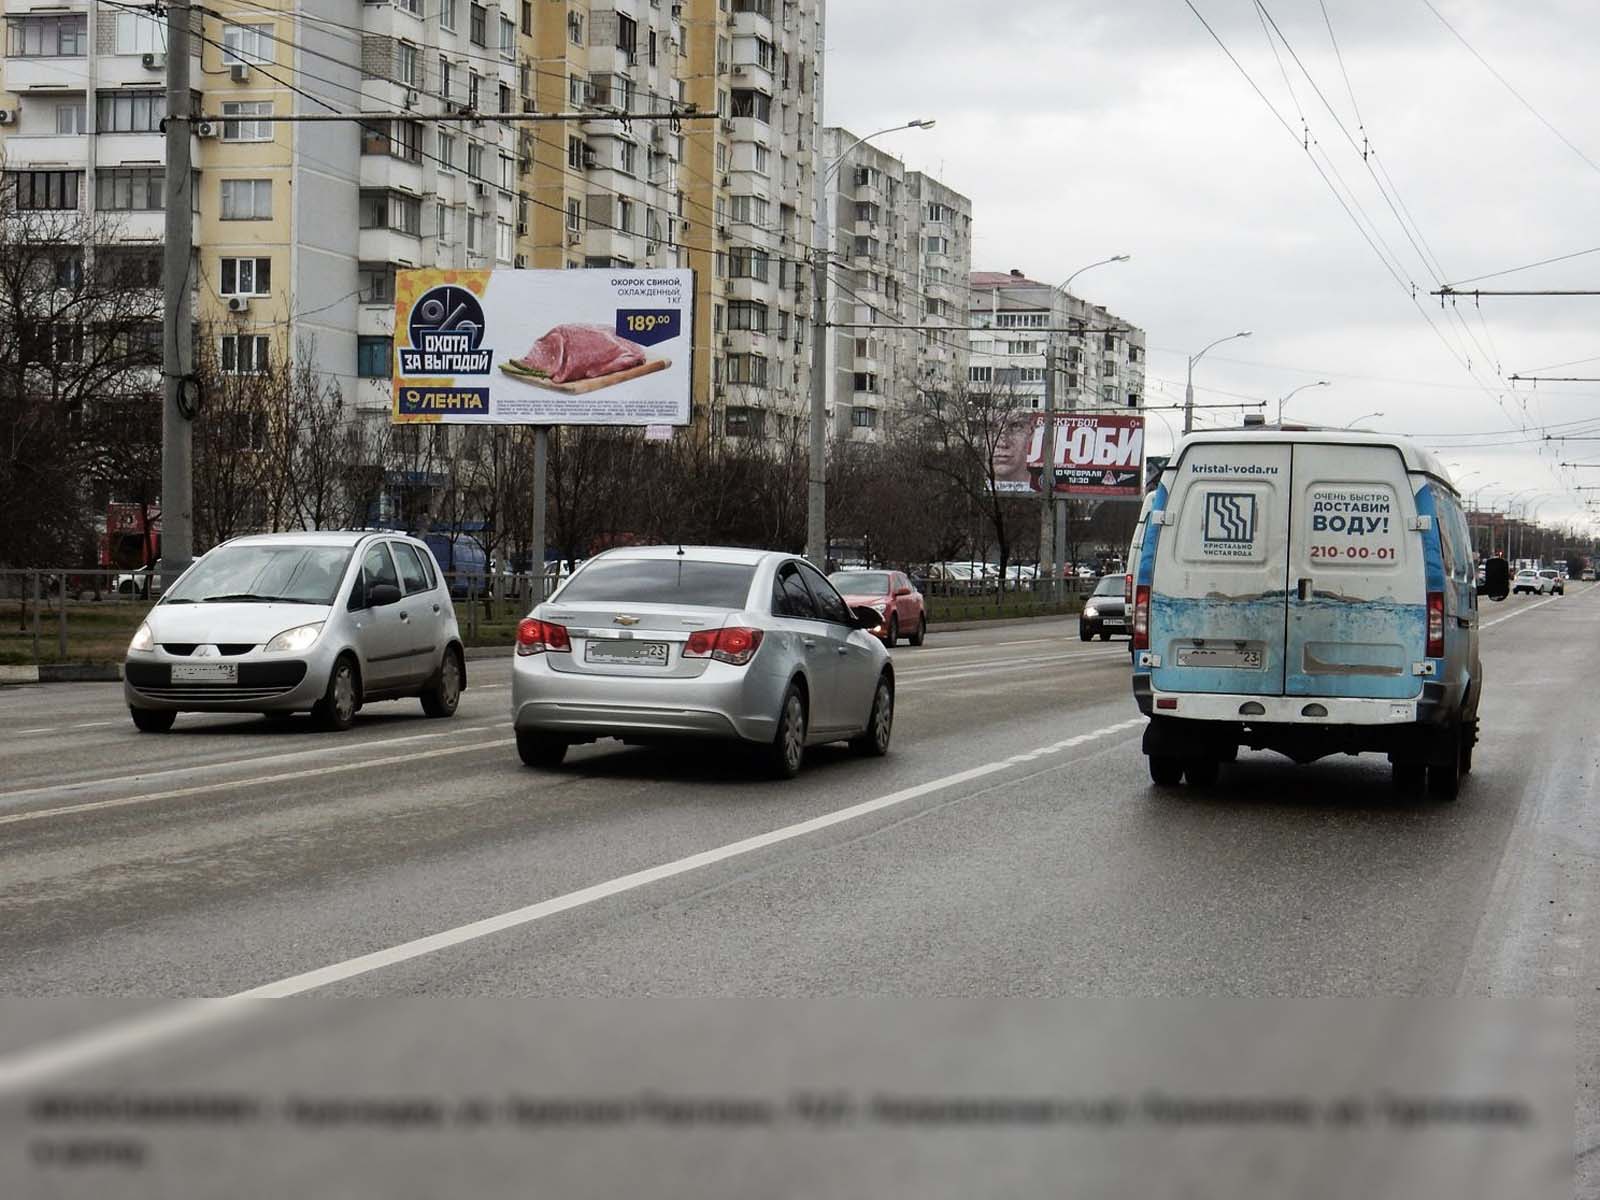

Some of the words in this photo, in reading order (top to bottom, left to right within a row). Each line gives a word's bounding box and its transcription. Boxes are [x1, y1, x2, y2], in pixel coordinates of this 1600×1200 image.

[646, 277, 682, 287] СВИНОЙ,
[425, 335, 469, 353] ОХОТА
[404, 354, 422, 370] ЗА
[424, 351, 489, 372] ВЫГОДОЙ
[421, 393, 483, 409] ЛЕНТА
[1192, 464, 1278, 474] kristal-voda.ru
[1350, 494, 1390, 502] БЫСТРО
[1314, 501, 1390, 513] ДОСТАВИМ
[1313, 515, 1389, 535] ВОДУ!
[1310, 546, 1395, 559] 210-00-01
